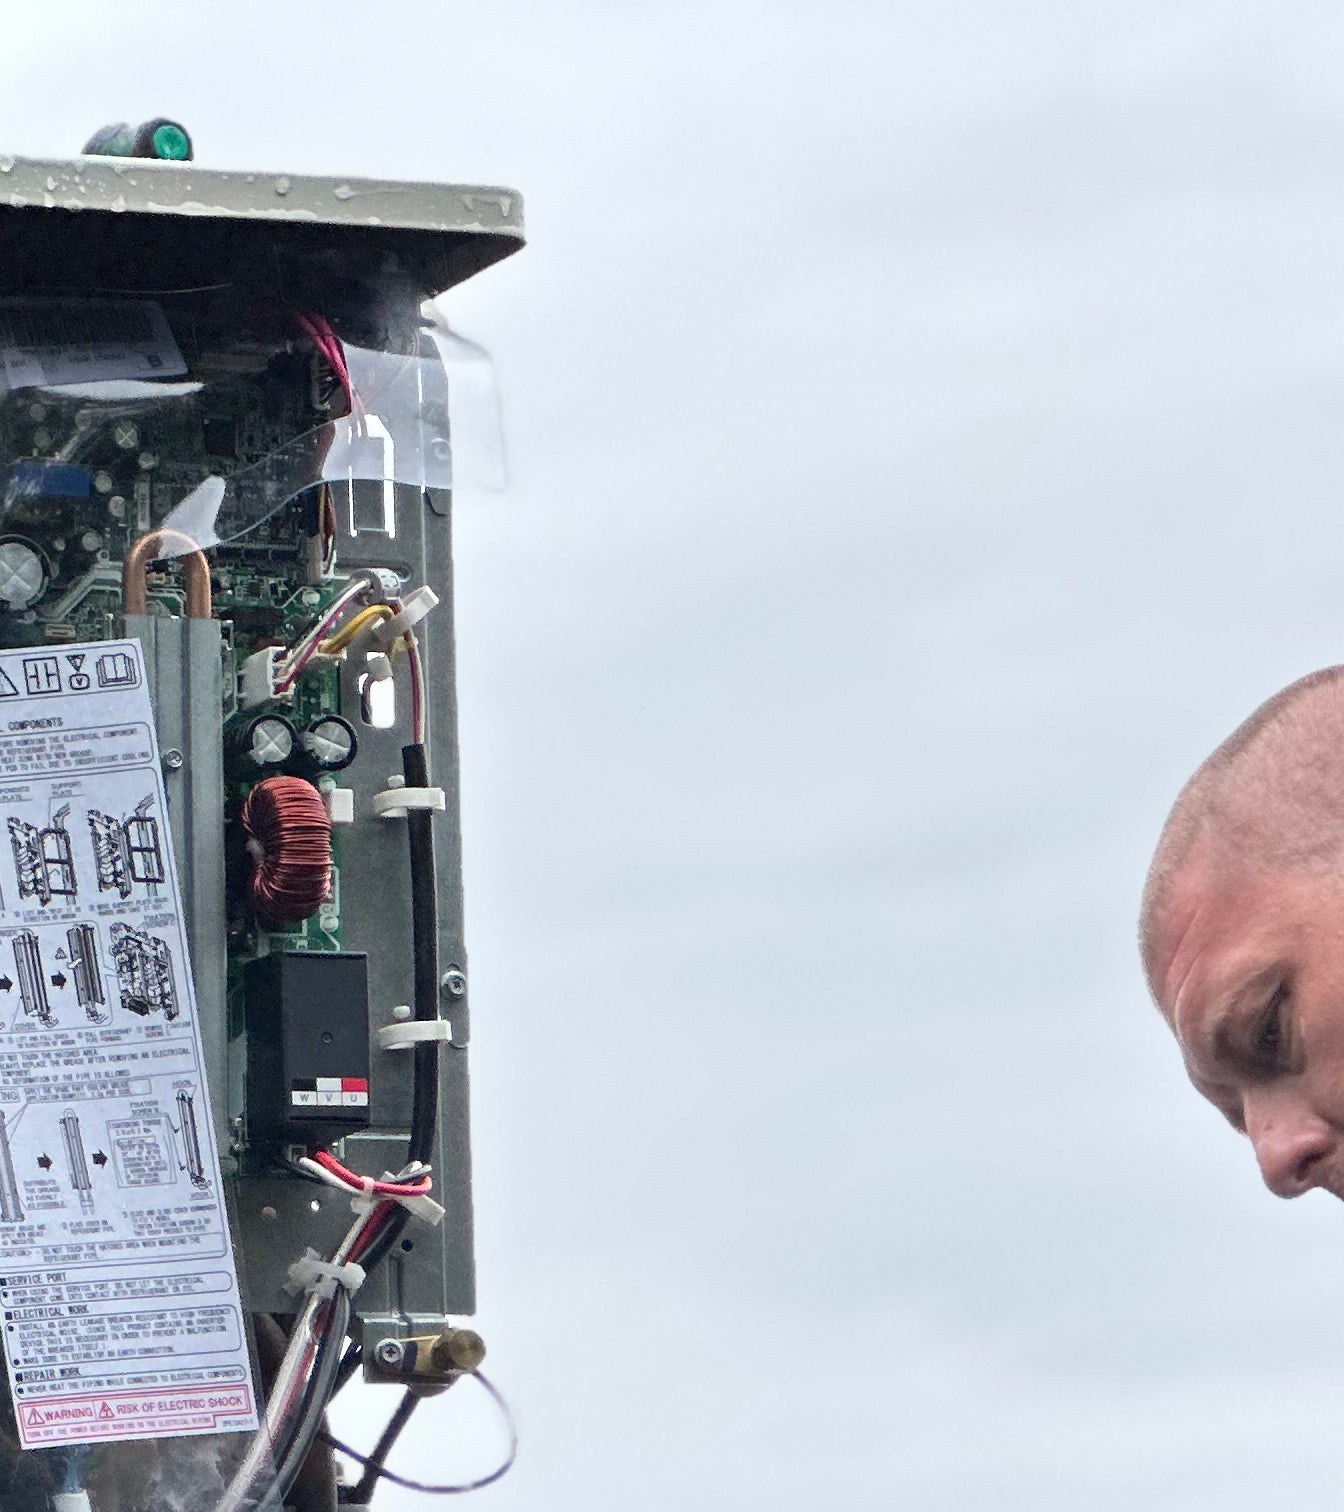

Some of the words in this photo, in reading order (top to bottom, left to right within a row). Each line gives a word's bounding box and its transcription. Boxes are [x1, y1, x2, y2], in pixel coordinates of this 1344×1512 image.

[6, 716, 64, 732] COMPONENTS
[299, 1094, 310, 1103] W
[325, 1094, 333, 1102] V
[349, 1094, 358, 1102] U
[6, 1274, 42, 1286] SERVICE
[45, 1271, 68, 1283] PORT
[12, 1306, 62, 1320] ELECTRICAL
[67, 1304, 90, 1315] WORK
[22, 1368, 56, 1380] REPAIR
[58, 1366, 82, 1378] WORK
[115, 1402, 139, 1416] RISK
[140, 1401, 155, 1414] OF
[156, 1397, 206, 1412] ELECTRIC
[207, 1393, 244, 1408] SHOCK
[42, 1406, 94, 1421] WARNING
